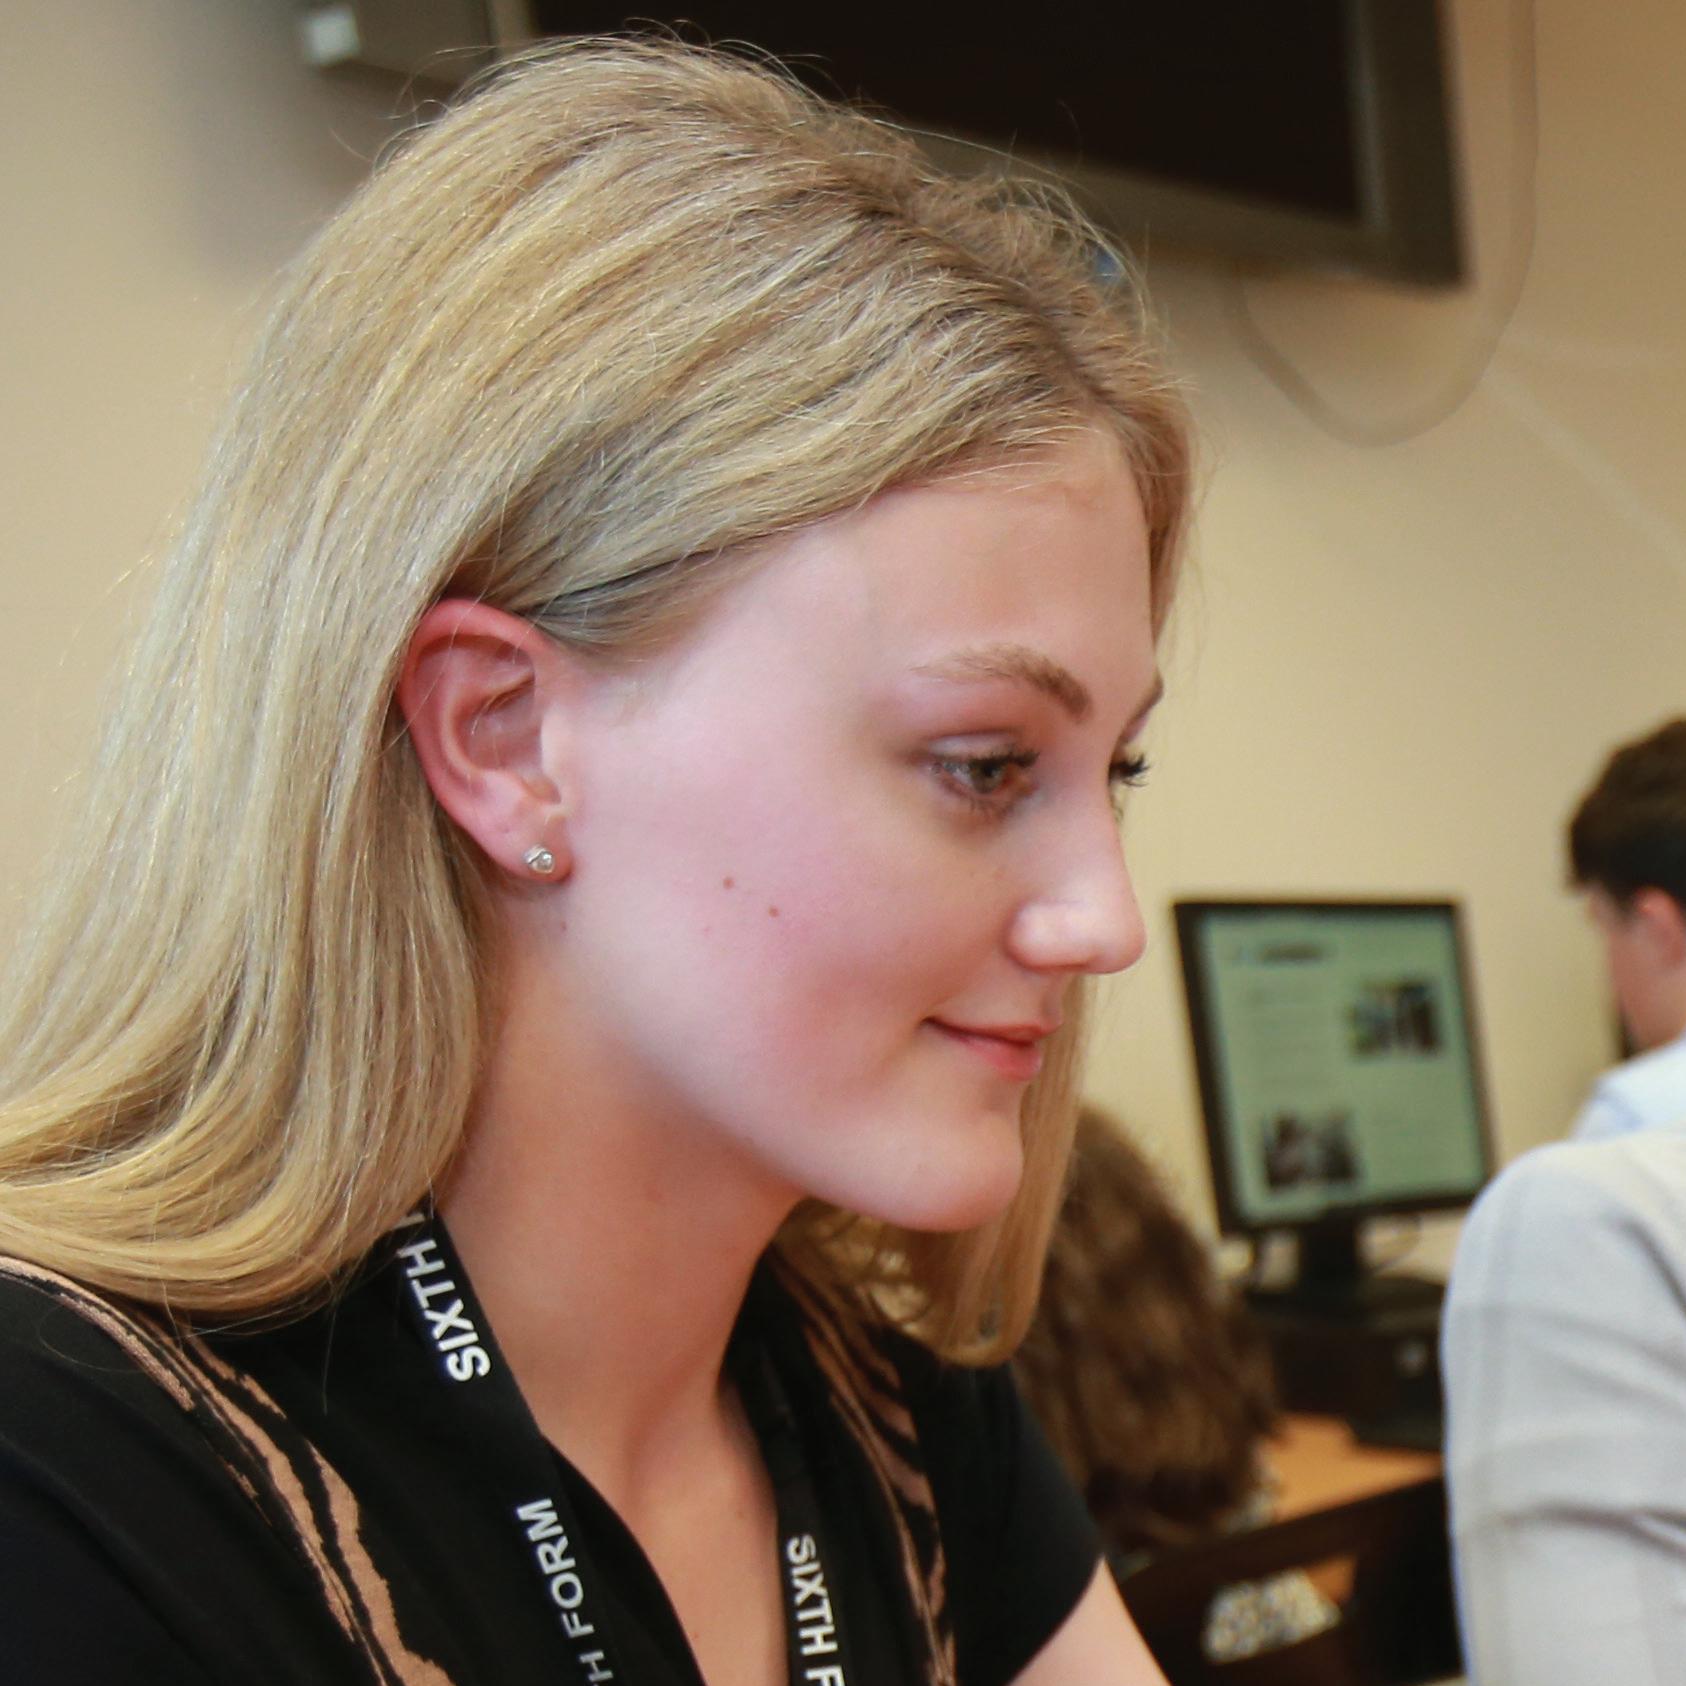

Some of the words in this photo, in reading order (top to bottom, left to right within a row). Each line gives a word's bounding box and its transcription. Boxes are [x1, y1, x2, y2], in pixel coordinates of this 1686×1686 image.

[397, 1239, 491, 1381] SIXTH
[516, 1498, 594, 1639] FORM
[788, 1535, 838, 1655] SIXTH
